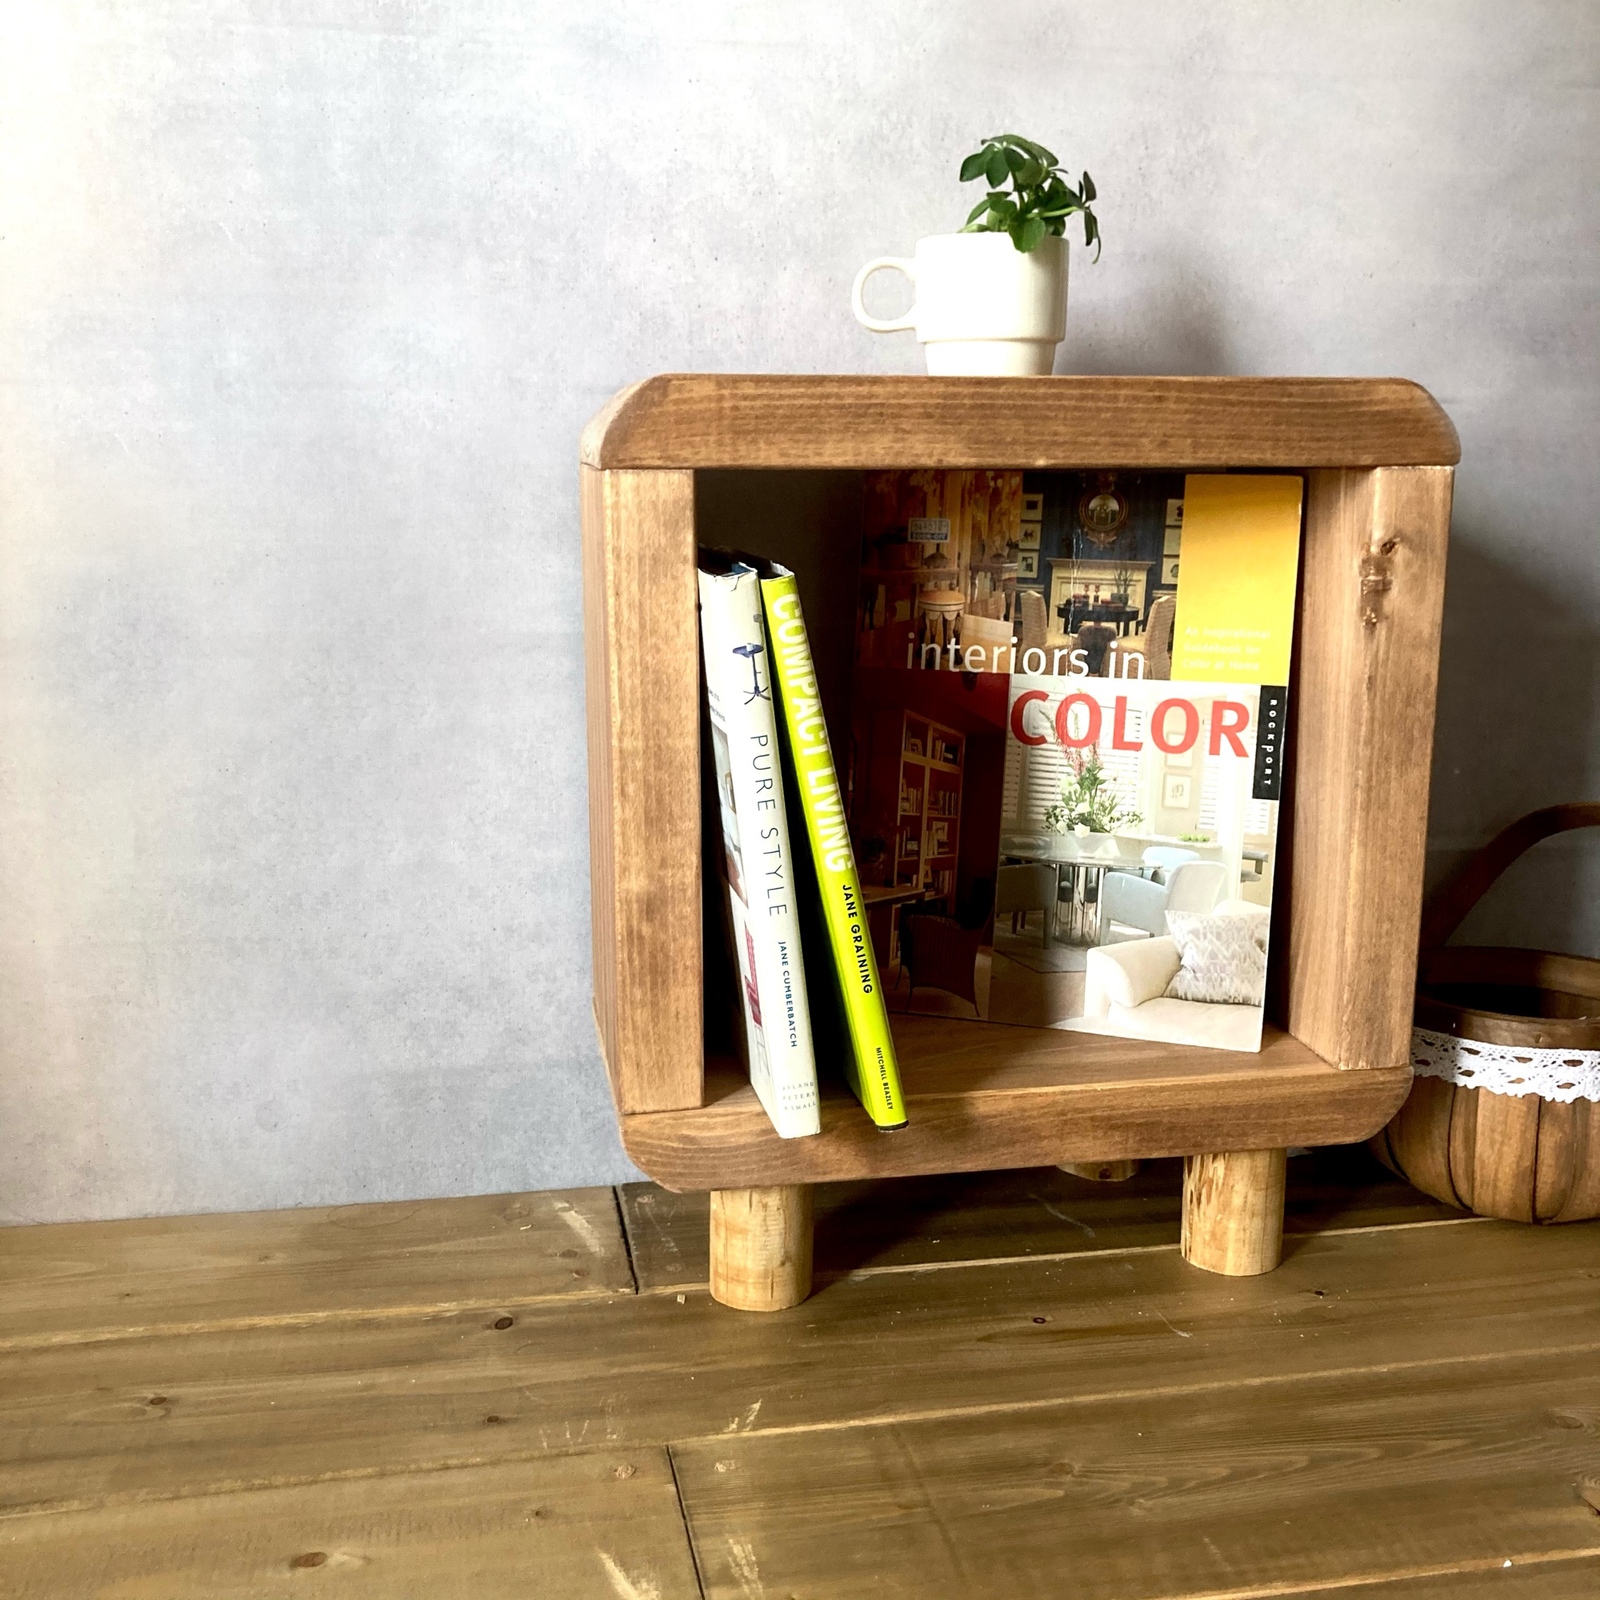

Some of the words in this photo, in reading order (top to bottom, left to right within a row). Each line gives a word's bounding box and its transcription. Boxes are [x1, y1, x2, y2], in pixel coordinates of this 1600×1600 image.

[906, 632, 1089, 677] interiors
[1108, 640, 1145, 680] in
[1182, 657, 1211, 669] Color
[1228, 659, 1260, 671] Home
[1010, 689, 1250, 758] COLOR
[750, 734, 776, 812] PURE
[807, 765, 854, 873] LIVING
[760, 827, 788, 917] STYLE
[778, 940, 789, 967] JANE
[842, 884, 858, 919] JANE
[850, 924, 873, 994] GRAINING
[782, 970, 797, 1048] CUMBERBATCH
[875, 1047, 887, 1081] MITCHELL
[882, 1082, 894, 1110] BEAZLEY
